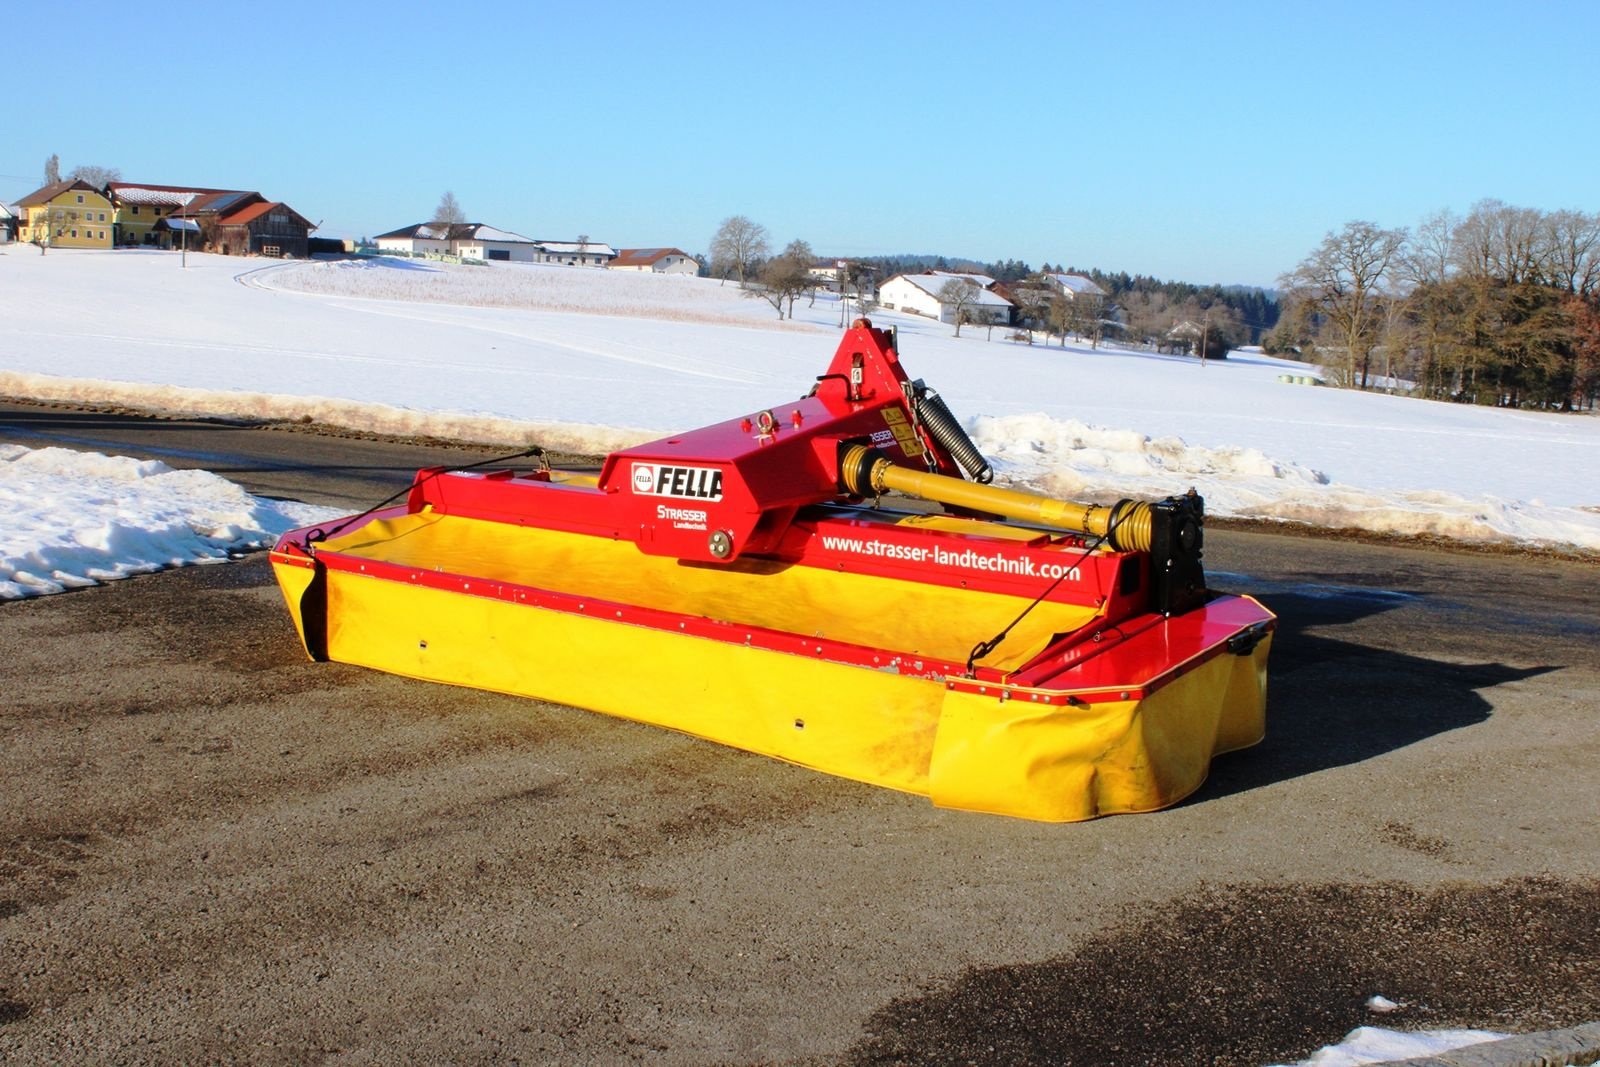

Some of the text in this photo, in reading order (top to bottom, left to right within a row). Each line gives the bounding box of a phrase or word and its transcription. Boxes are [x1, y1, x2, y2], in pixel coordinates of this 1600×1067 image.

[636, 475, 652, 483] FELLA
[656, 467, 722, 498] FELLA
[673, 521, 707, 530] Landtechnik
[822, 535, 1081, 581] www.strasser-landtechnik.com
